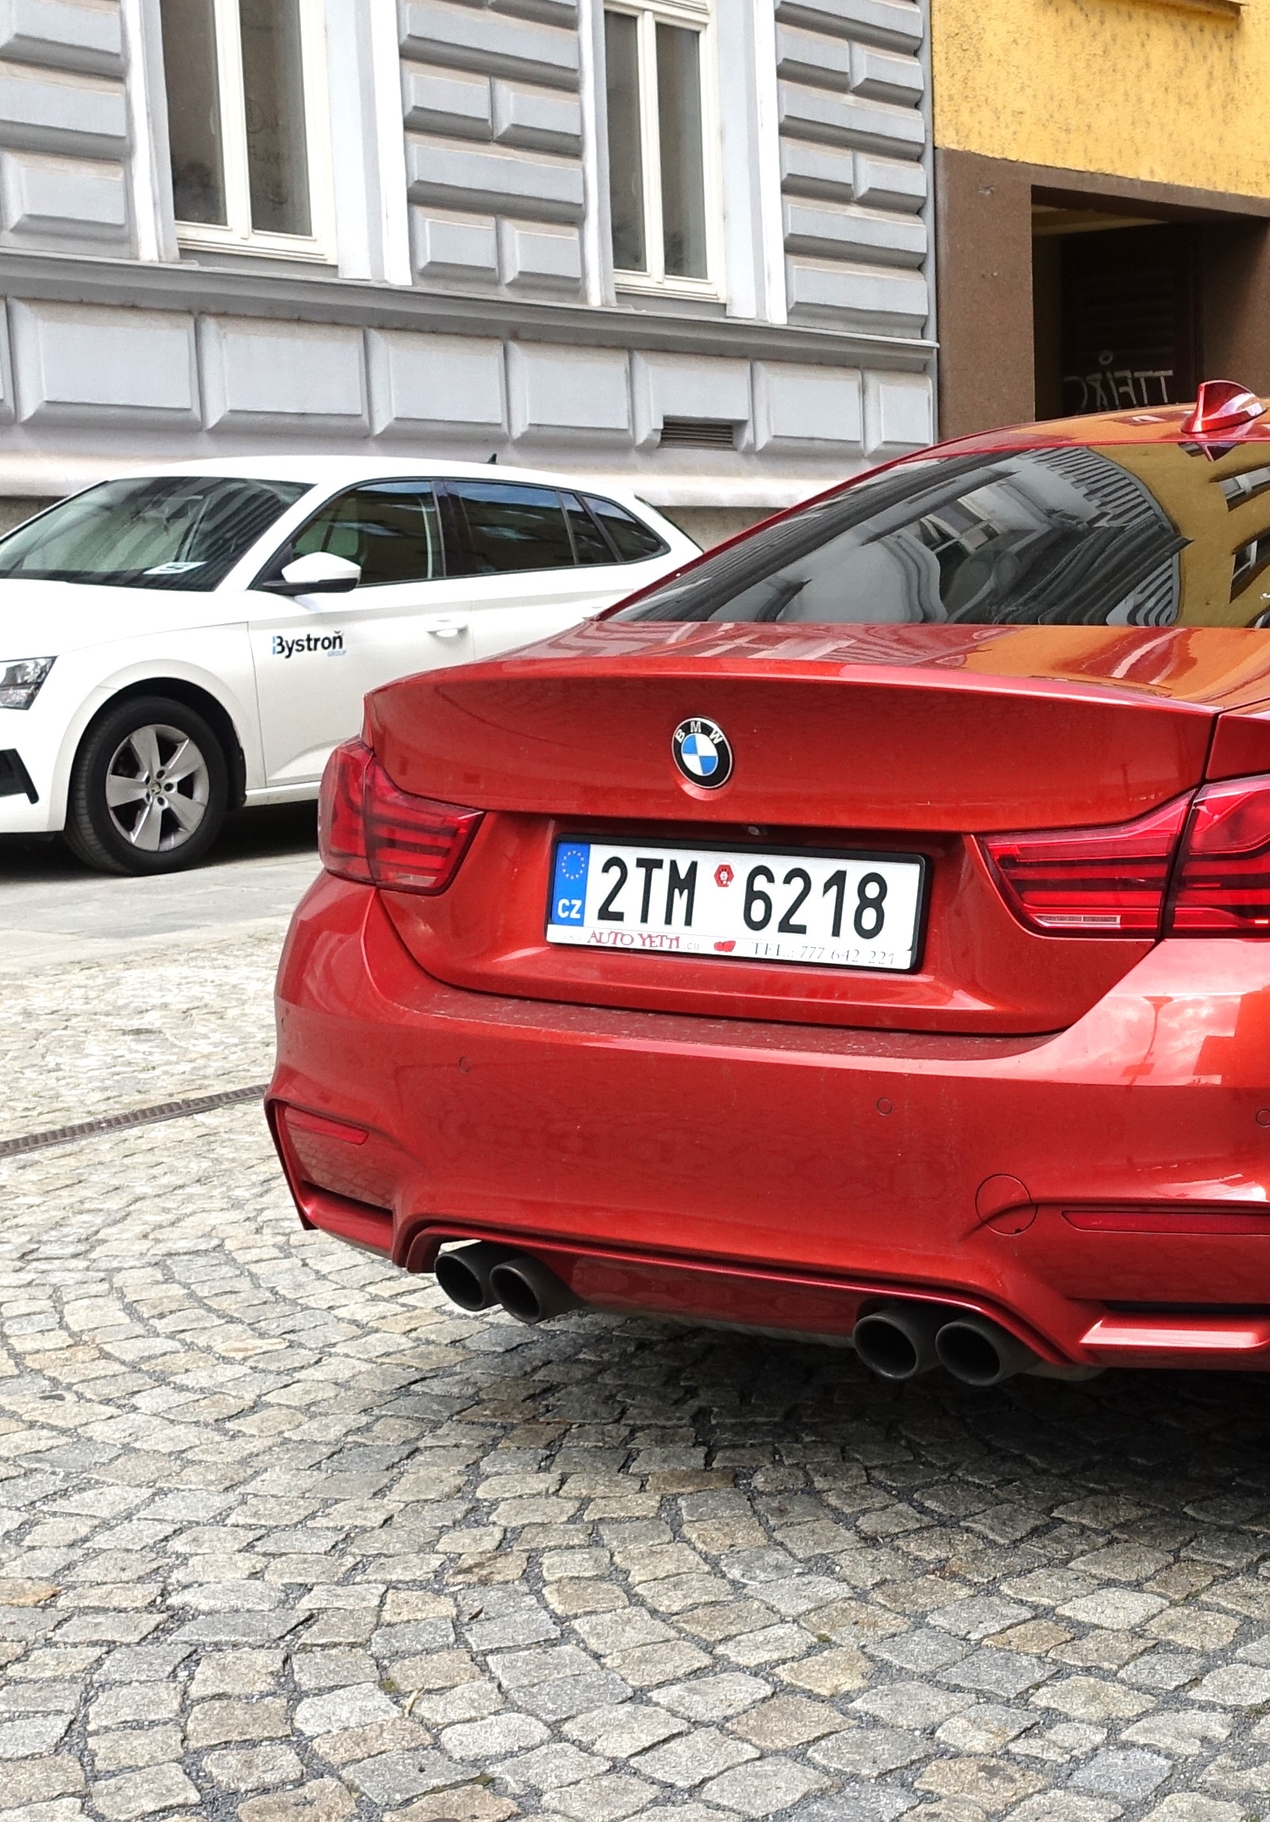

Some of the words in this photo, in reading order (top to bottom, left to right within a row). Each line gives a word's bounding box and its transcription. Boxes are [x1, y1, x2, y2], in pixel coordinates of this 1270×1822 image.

[272, 630, 343, 659] Bystroň
[675, 721, 723, 745] BMW
[597, 856, 698, 926] 2TM
[743, 864, 888, 939] 6218
[557, 899, 582, 919] CZ
[587, 930, 634, 946] AUTO
[800, 945, 825, 960] 777
